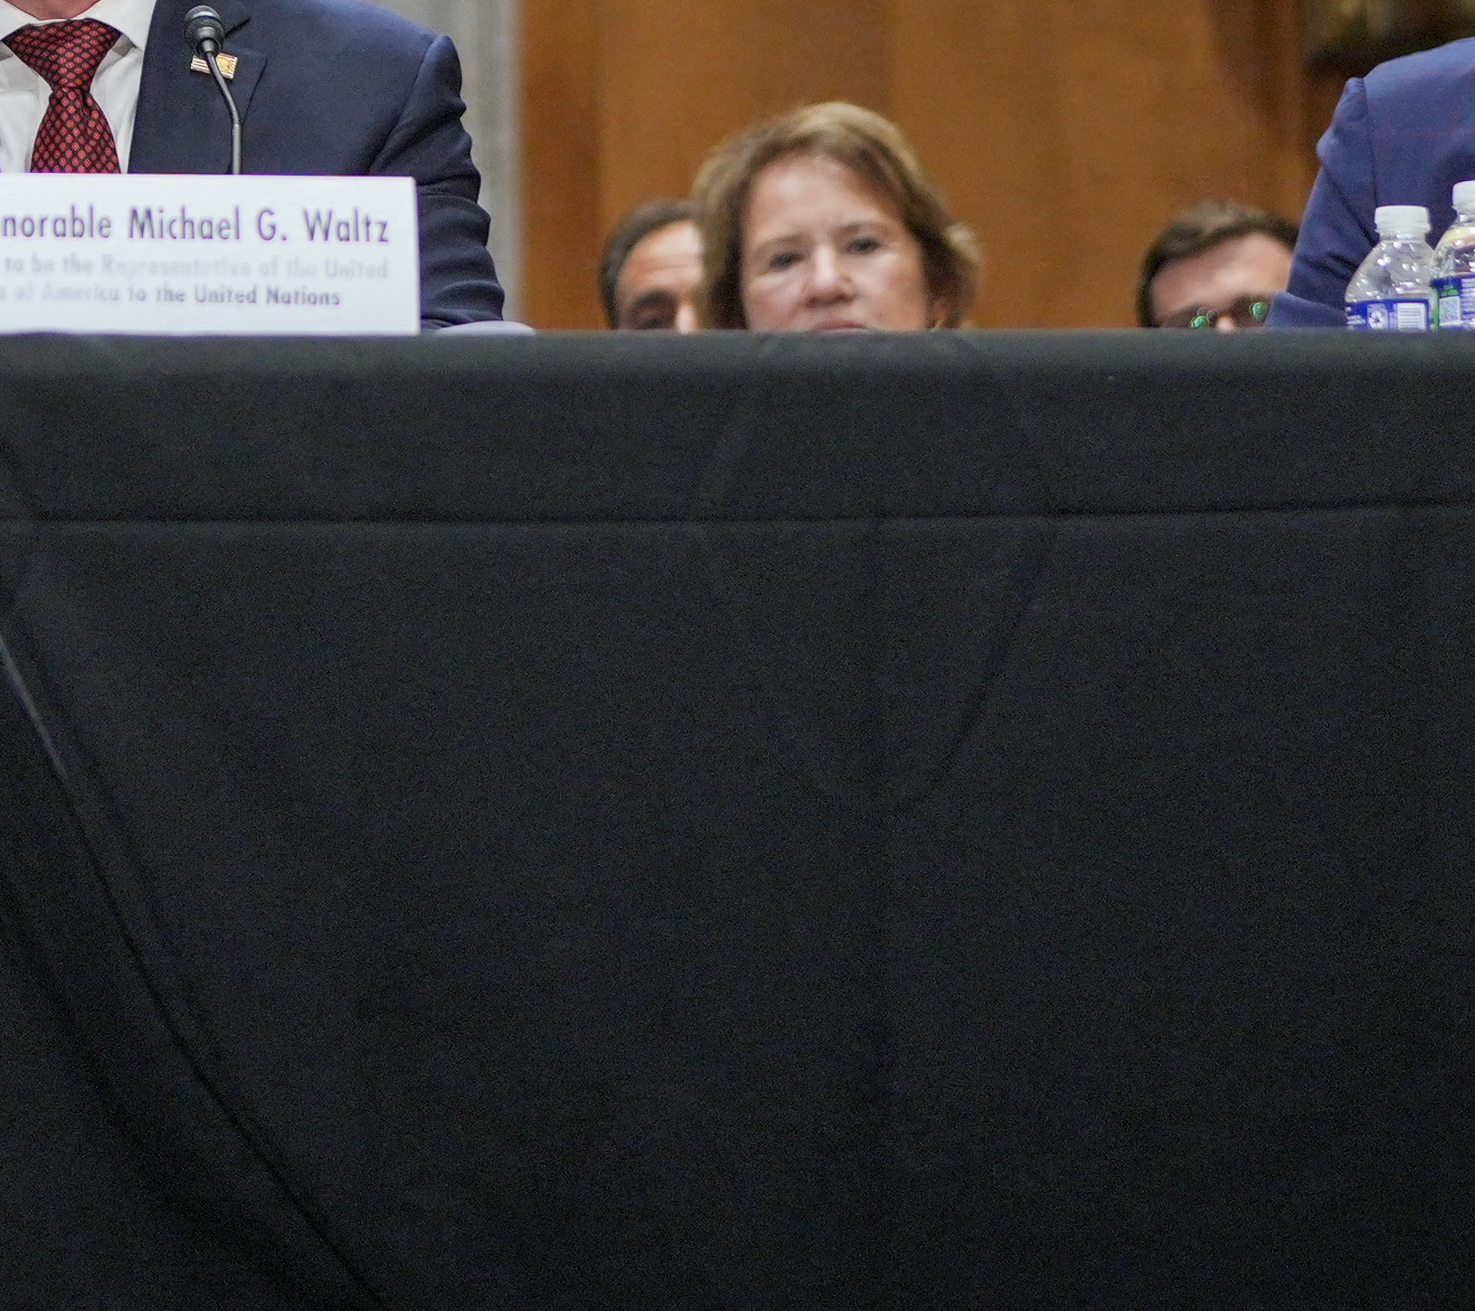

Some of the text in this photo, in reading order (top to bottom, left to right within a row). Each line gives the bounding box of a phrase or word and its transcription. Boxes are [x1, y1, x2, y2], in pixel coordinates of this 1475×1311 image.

[127, 205, 241, 240] Michael
[257, 208, 287, 242] G.
[302, 207, 389, 243] Waltz
[4, 255, 24, 272] to
[31, 251, 55, 272] be
[63, 252, 93, 273] the
[324, 258, 388, 279] United
[128, 284, 147, 303] to
[155, 282, 186, 304] the
[193, 284, 257, 305] United
[265, 286, 341, 306] Nations
